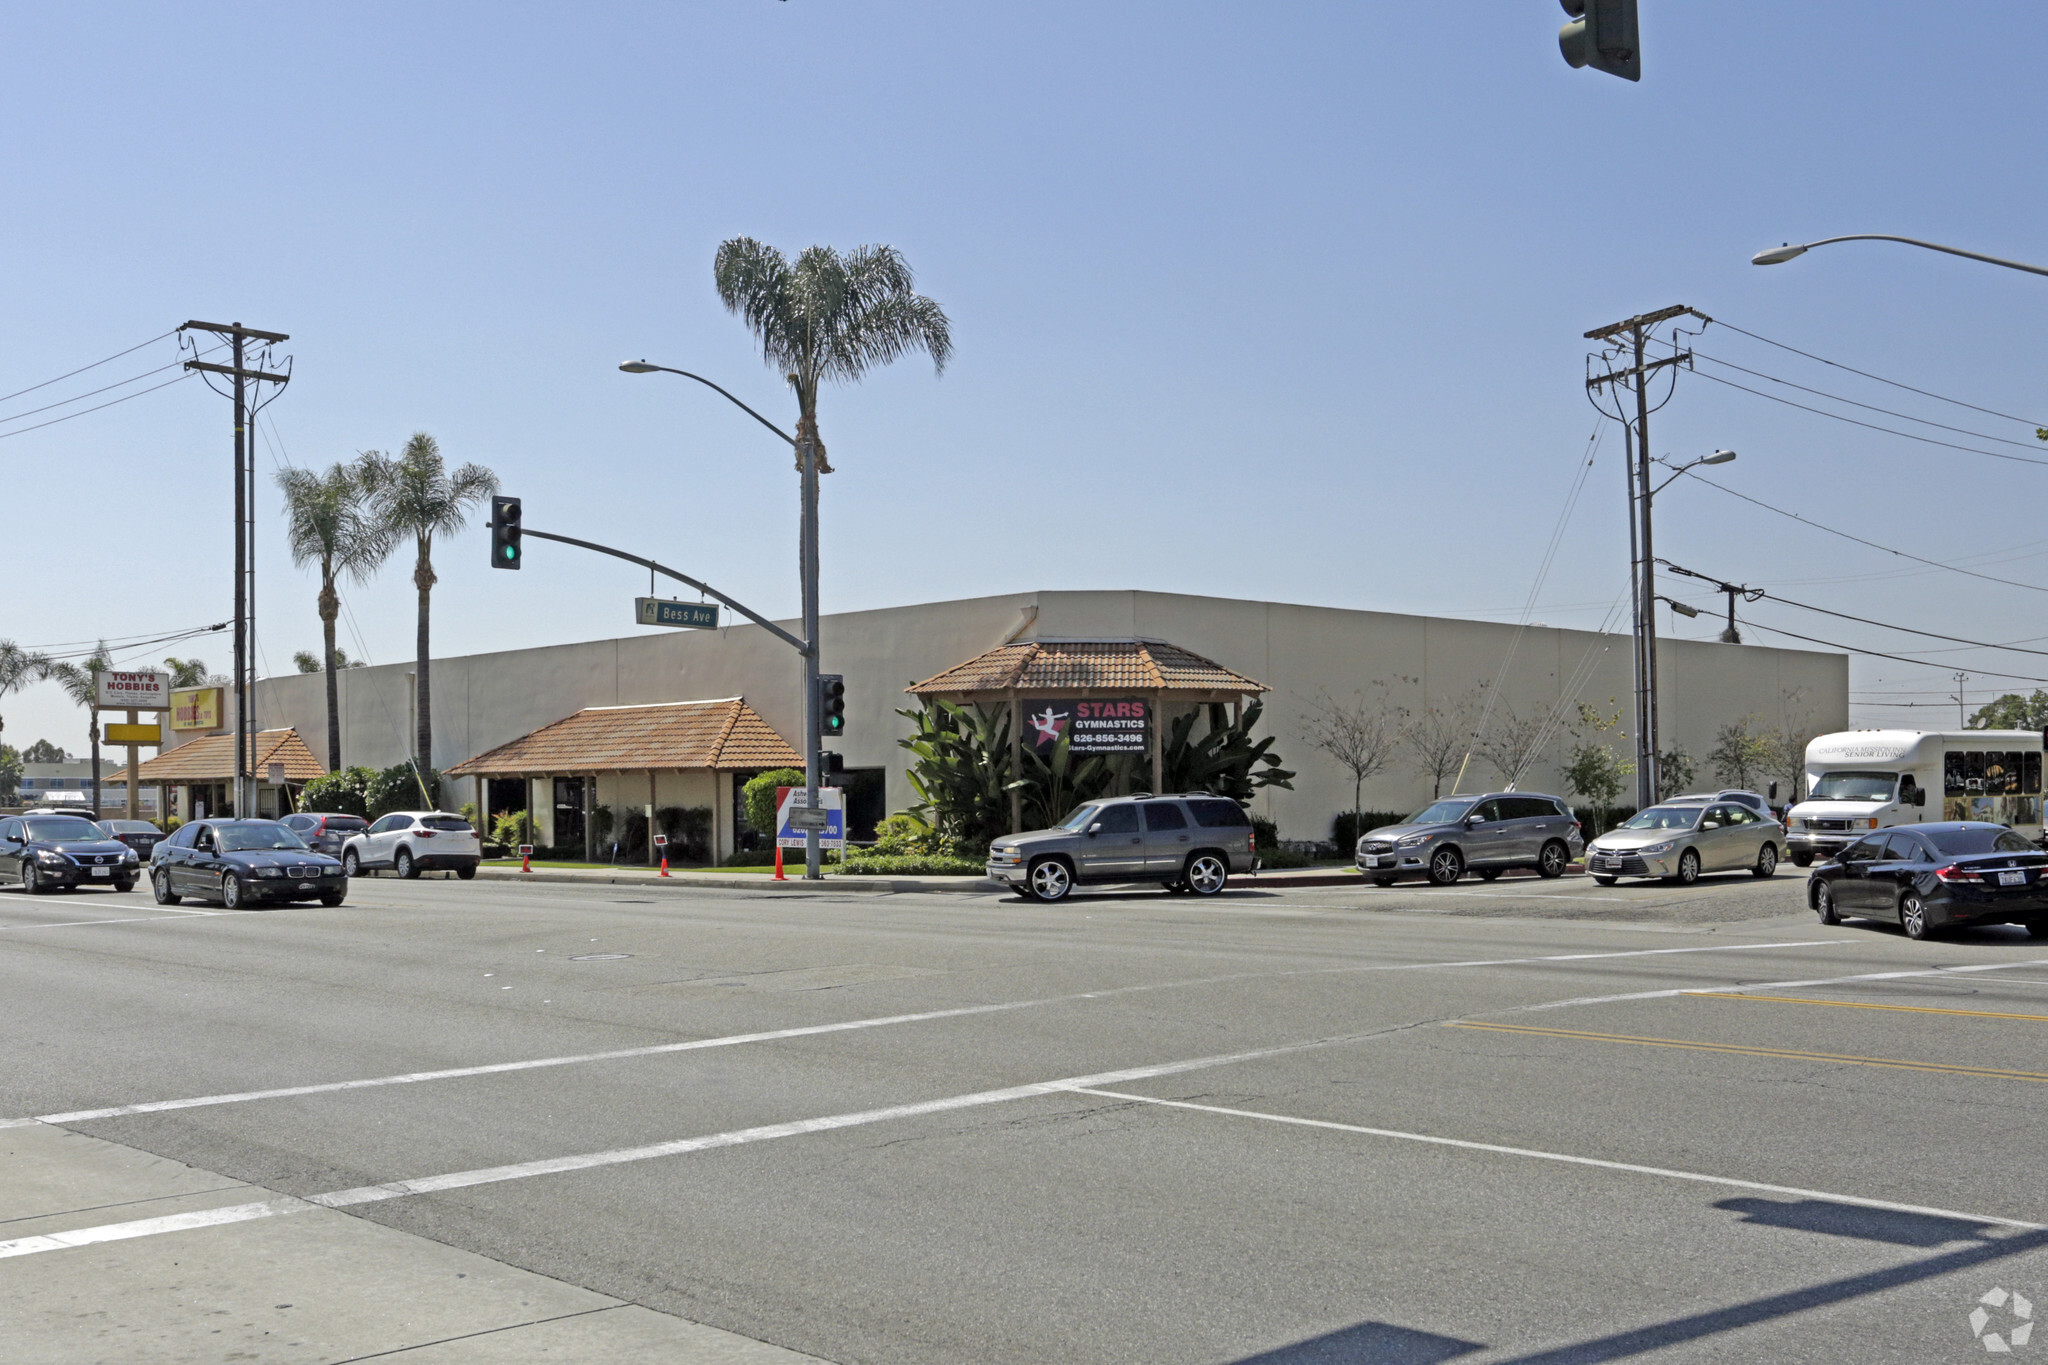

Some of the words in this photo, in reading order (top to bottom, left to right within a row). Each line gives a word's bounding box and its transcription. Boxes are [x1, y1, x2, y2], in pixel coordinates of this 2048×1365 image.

[663, 607, 689, 621] Bess
[693, 610, 711, 623] Ave
[112, 672, 155, 682] TONY'S
[107, 682, 160, 692] HOBBIES
[1077, 702, 1145, 717] STARS
[1076, 720, 1145, 729] GYMNASTICS
[1073, 734, 1143, 742] 626-856-3496
[1818, 746, 1859, 754] CALIFORNIA
